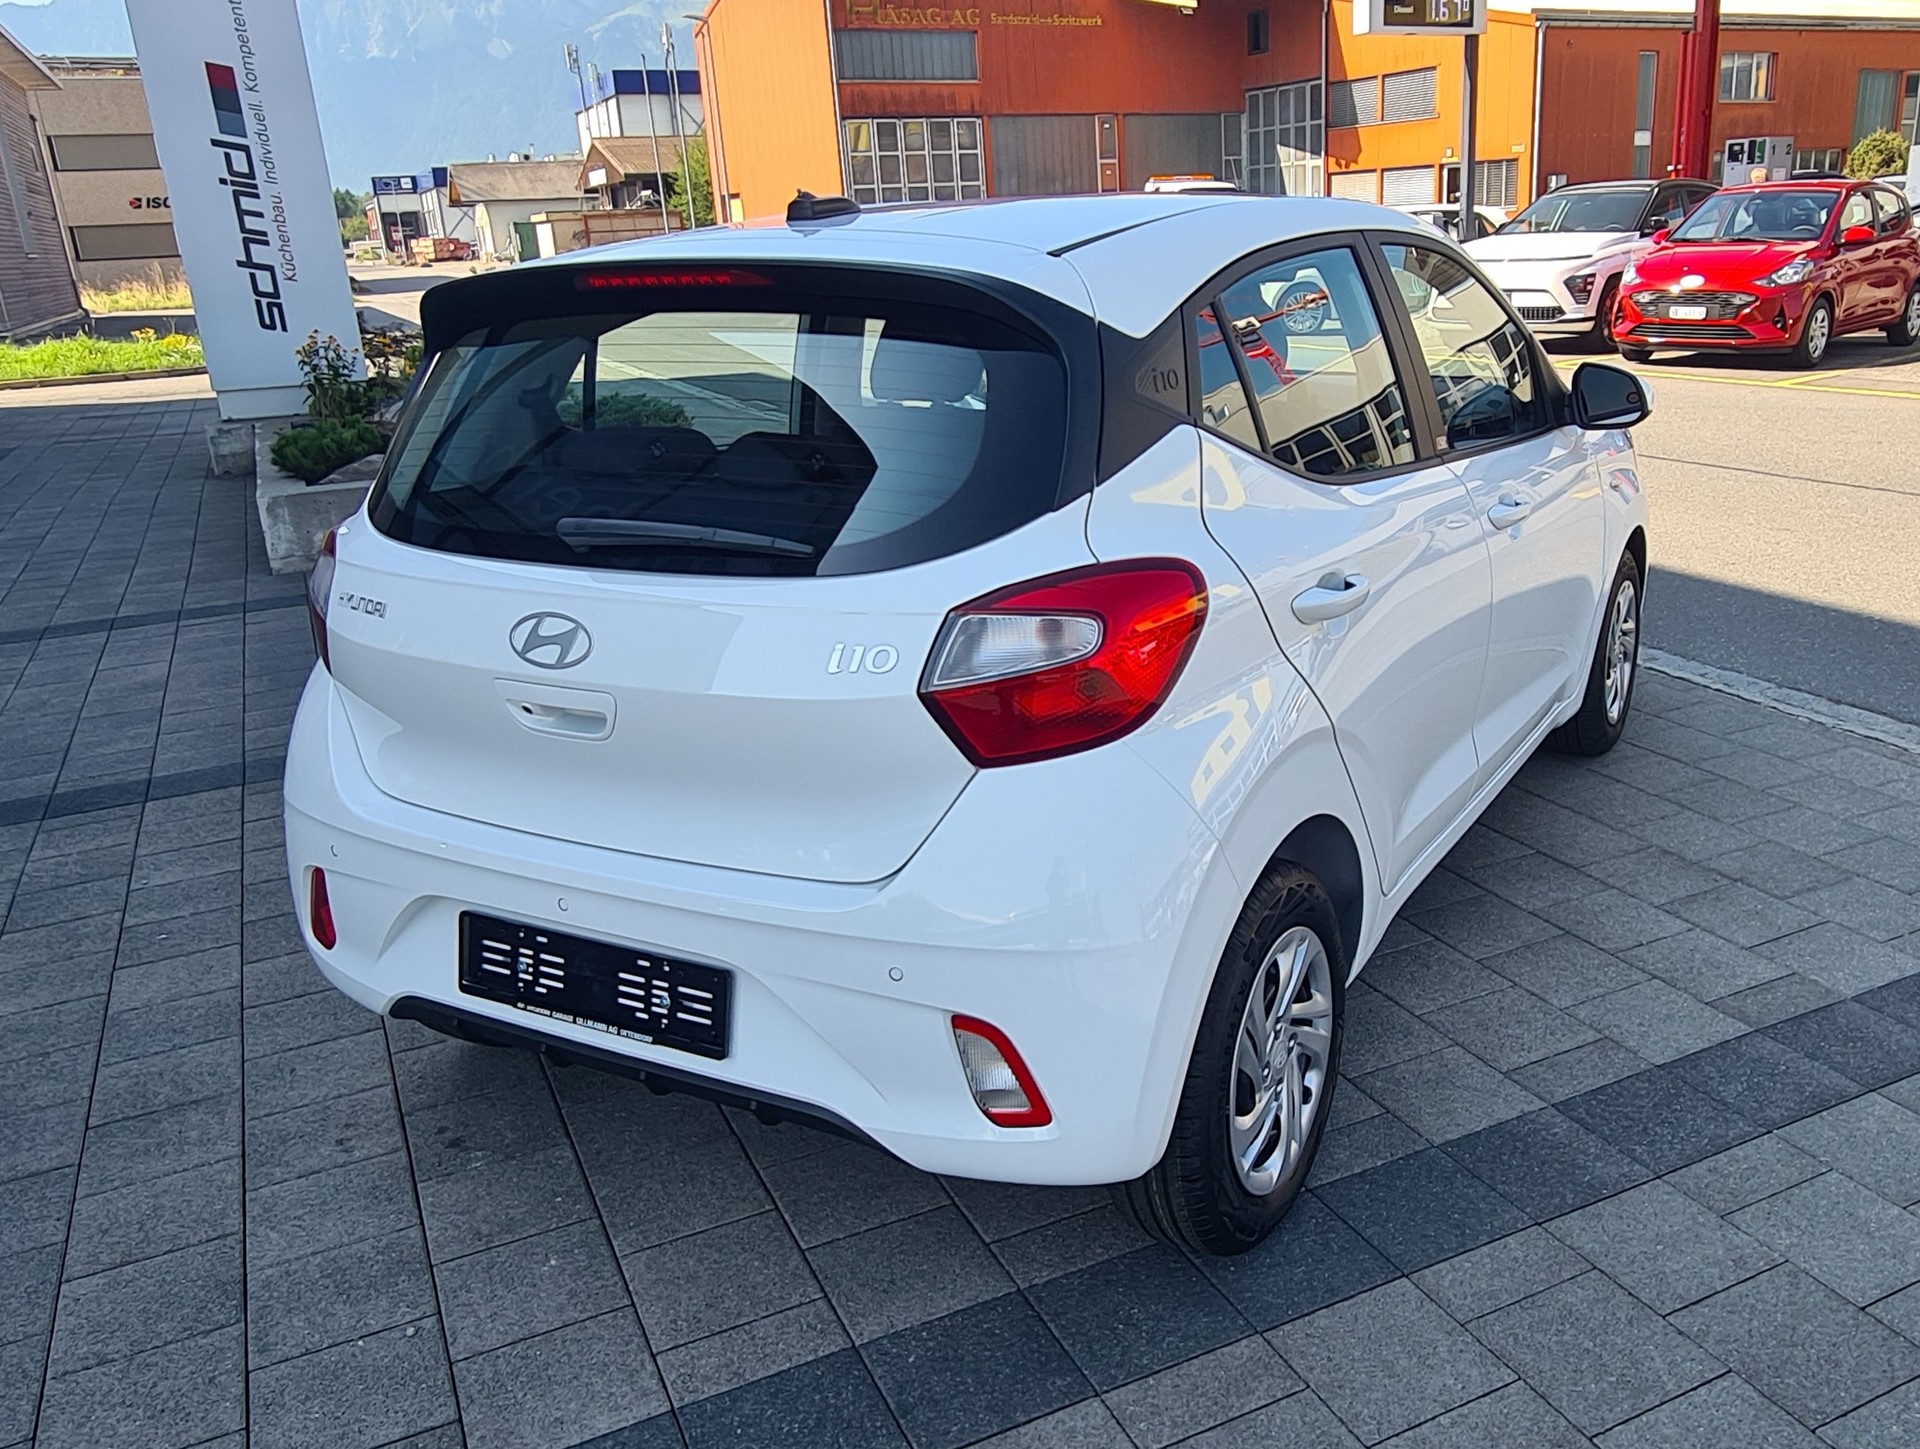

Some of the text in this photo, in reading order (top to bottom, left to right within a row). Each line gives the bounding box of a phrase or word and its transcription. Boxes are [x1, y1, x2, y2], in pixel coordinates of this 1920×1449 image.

[951, 8, 981, 25] AG
[248, 100, 278, 185] Individuell.
[1771, 144, 1776, 155] 1
[1785, 144, 1792, 155] 2
[209, 137, 289, 334] schmid
[270, 190, 298, 282] Küchenbau.
[1151, 367, 1179, 393] i10
[827, 642, 899, 675] i10
[608, 1025, 619, 1035] AG
